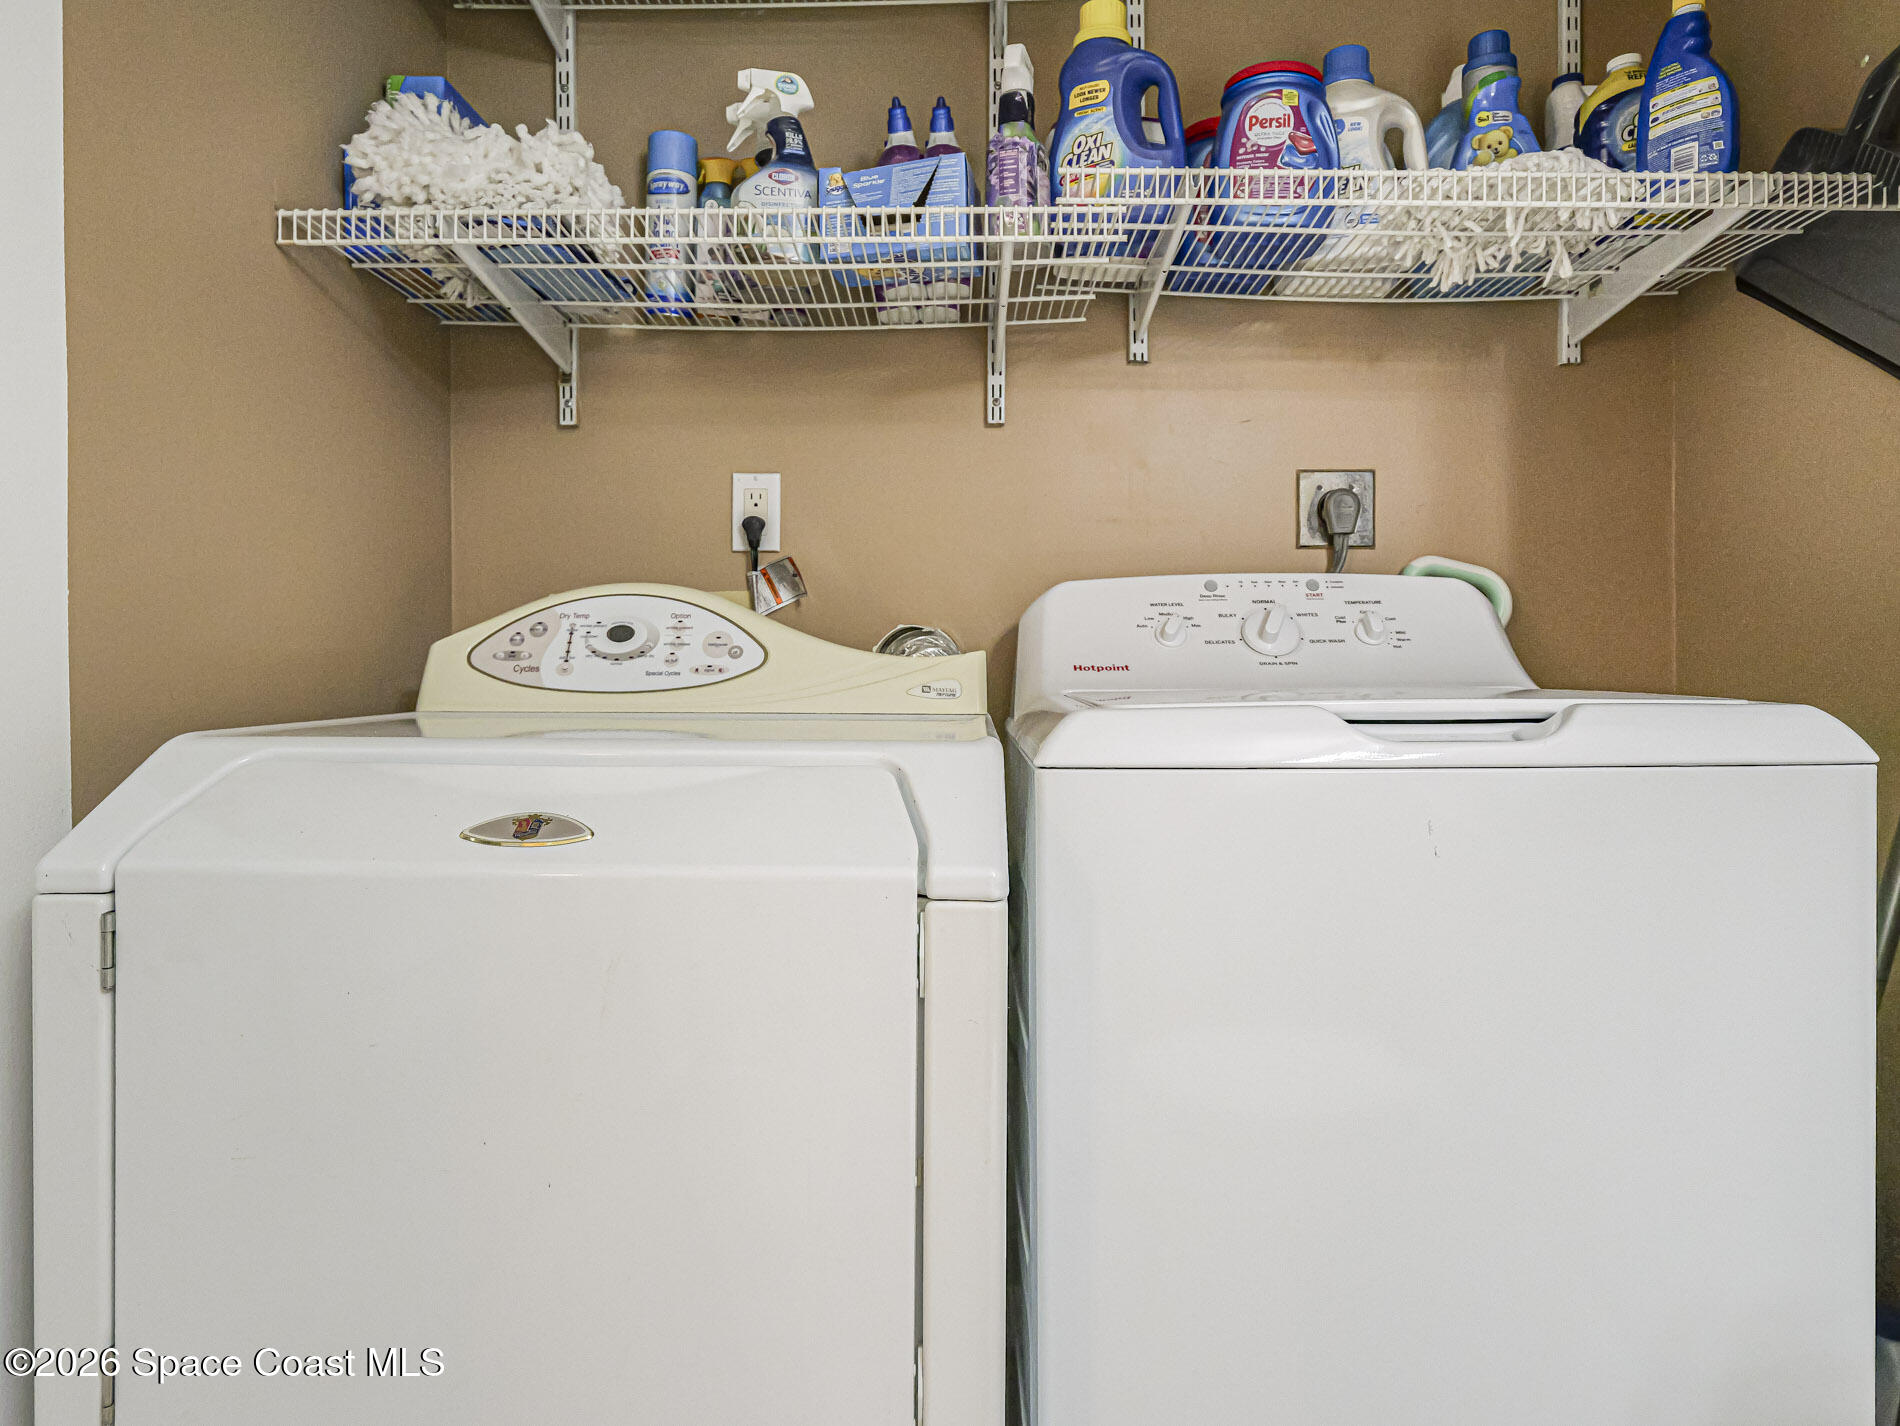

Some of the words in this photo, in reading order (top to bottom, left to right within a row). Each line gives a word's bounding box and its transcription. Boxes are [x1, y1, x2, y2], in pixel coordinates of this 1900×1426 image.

[1073, 91, 1087, 99] LOOK
[1087, 87, 1106, 95] NEWER
[1079, 95, 1099, 103] LONGER
[1248, 113, 1291, 132] Persil
[785, 131, 803, 139] KILLS
[1071, 131, 1104, 155] OXI
[1061, 142, 1113, 168] CLEAN
[852, 178, 886, 189] Sparkle
[860, 174, 879, 182] Blue
[754, 184, 812, 199] SCENTIVA
[513, 664, 540, 674] Cycles
[1073, 664, 1130, 673] Hotpoint
